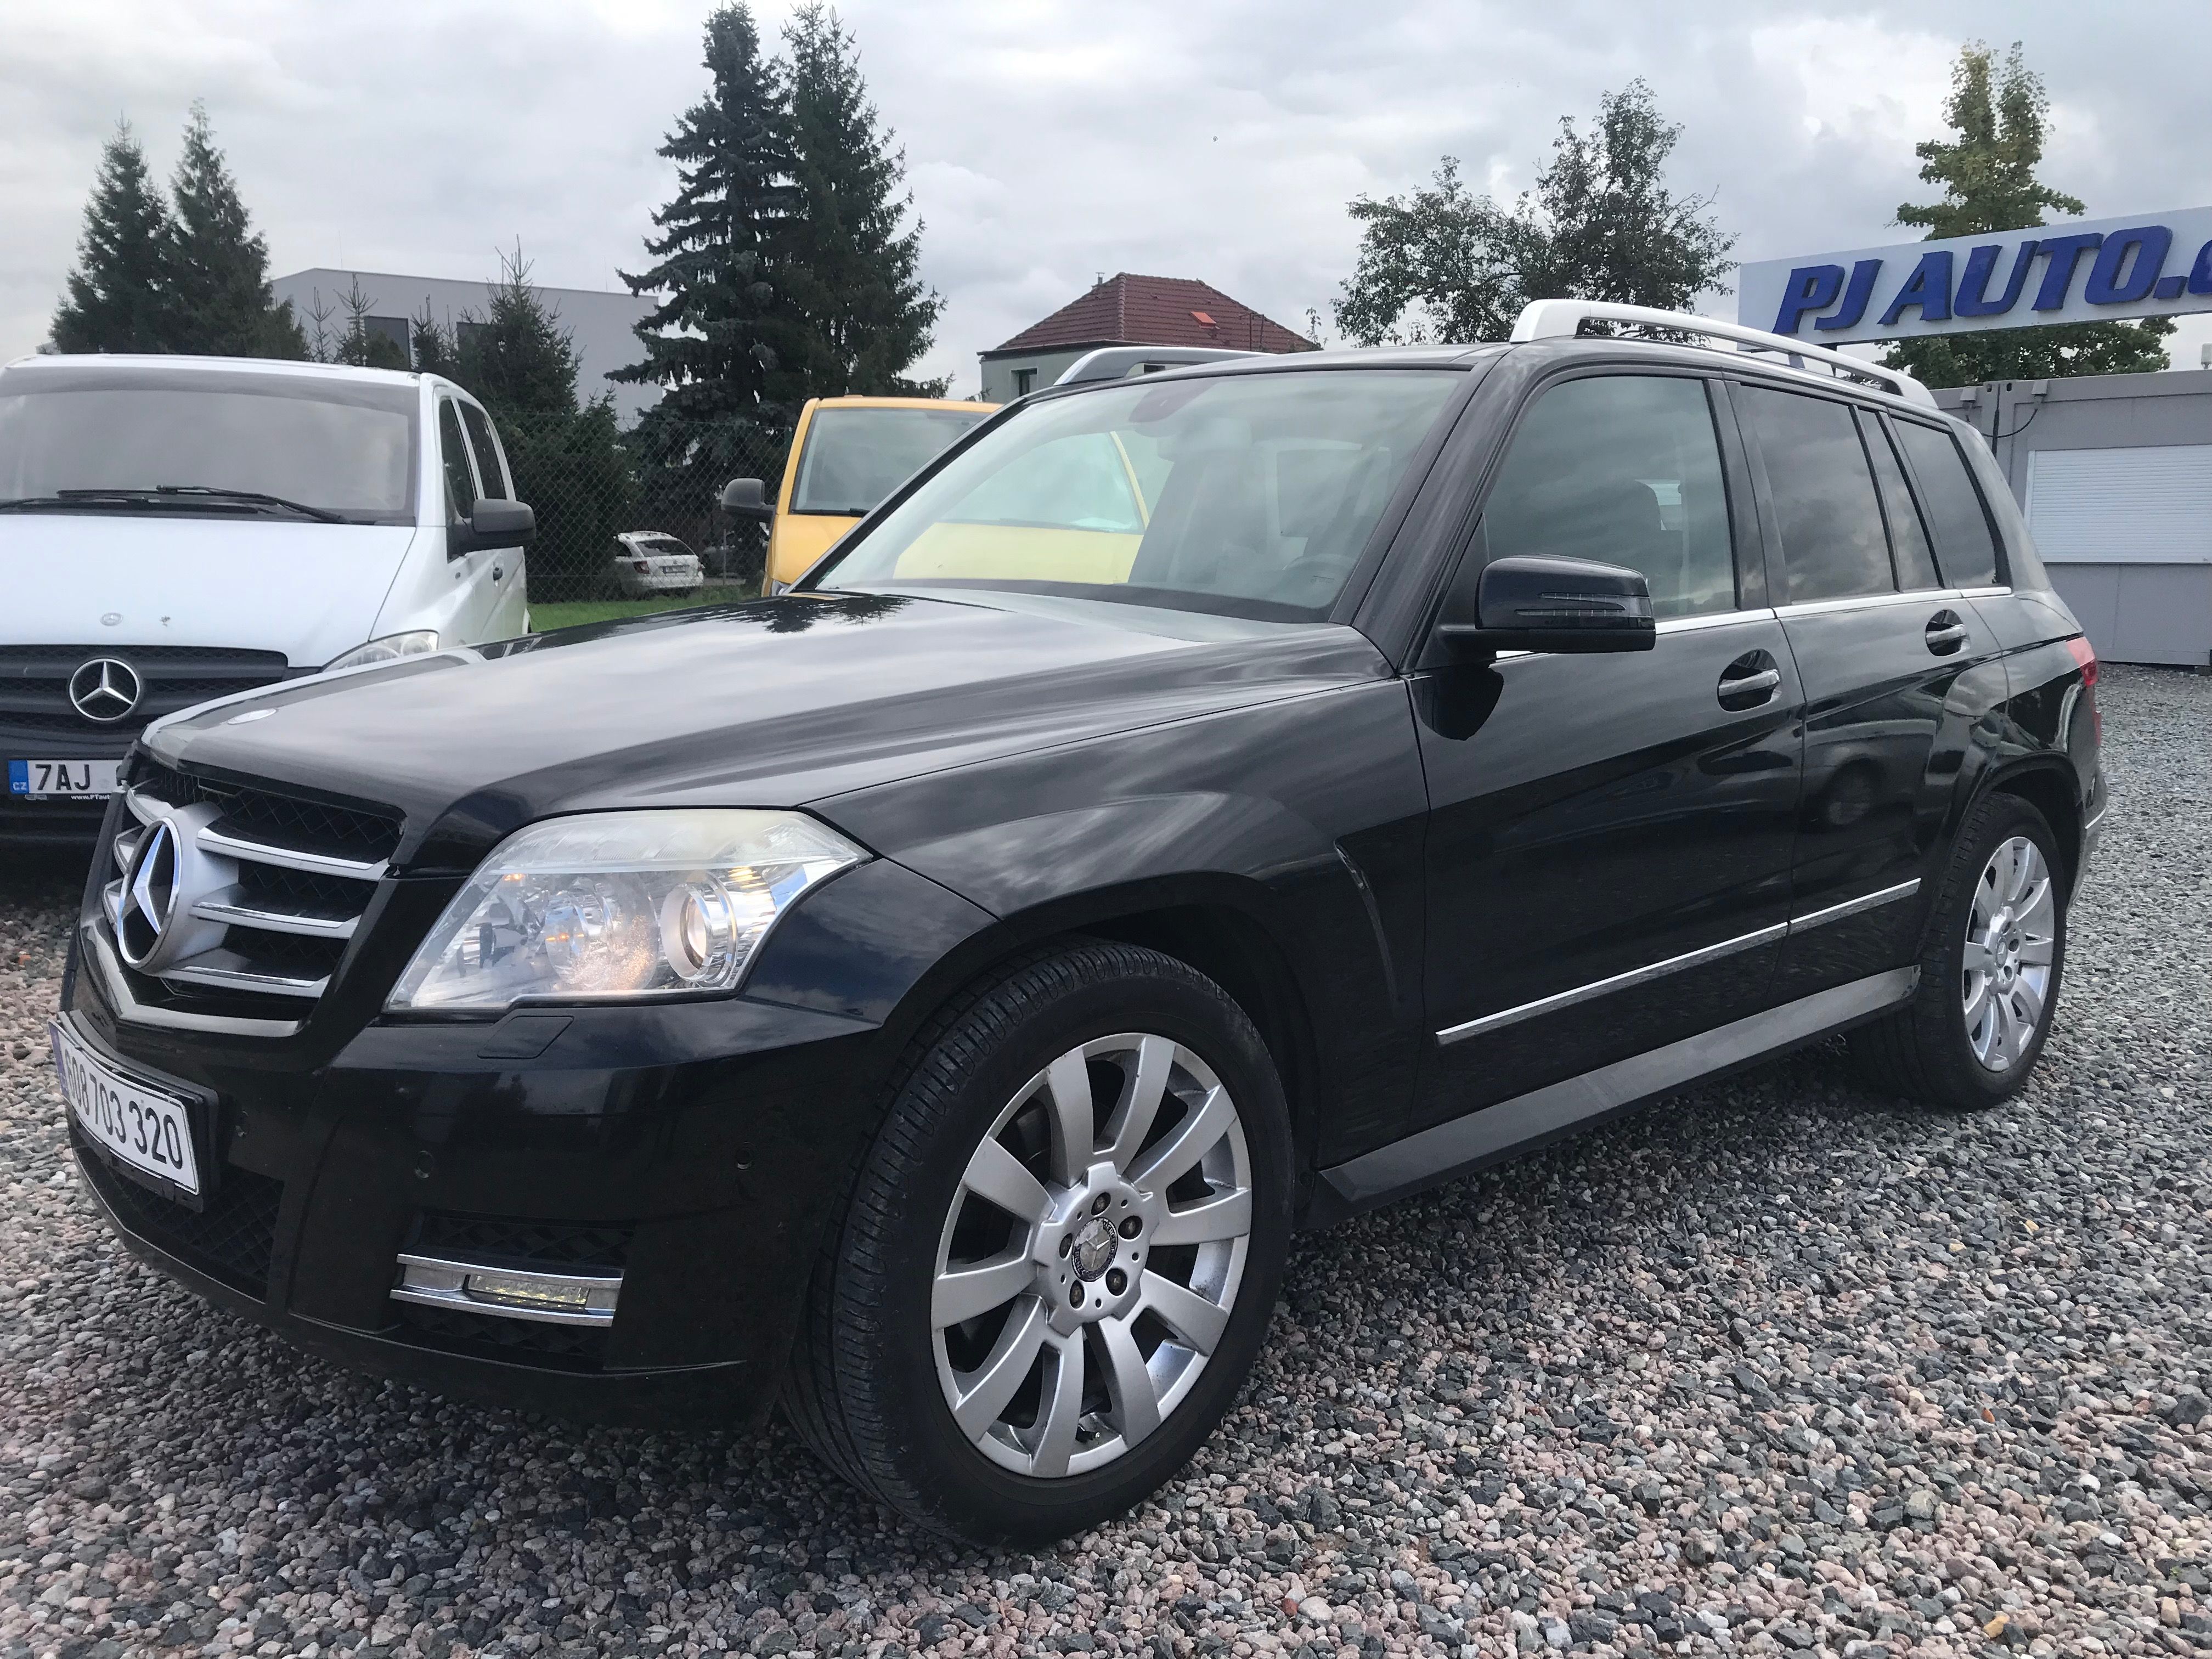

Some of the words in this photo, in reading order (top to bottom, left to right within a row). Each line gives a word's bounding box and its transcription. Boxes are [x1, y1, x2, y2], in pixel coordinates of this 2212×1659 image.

[1773, 258, 1883, 335] PJ
[12, 781, 27, 791] CZ
[35, 764, 91, 791] 7AJ
[65, 1048, 90, 1116] 608
[89, 1072, 127, 1144] 703
[128, 1100, 183, 1170] 320
